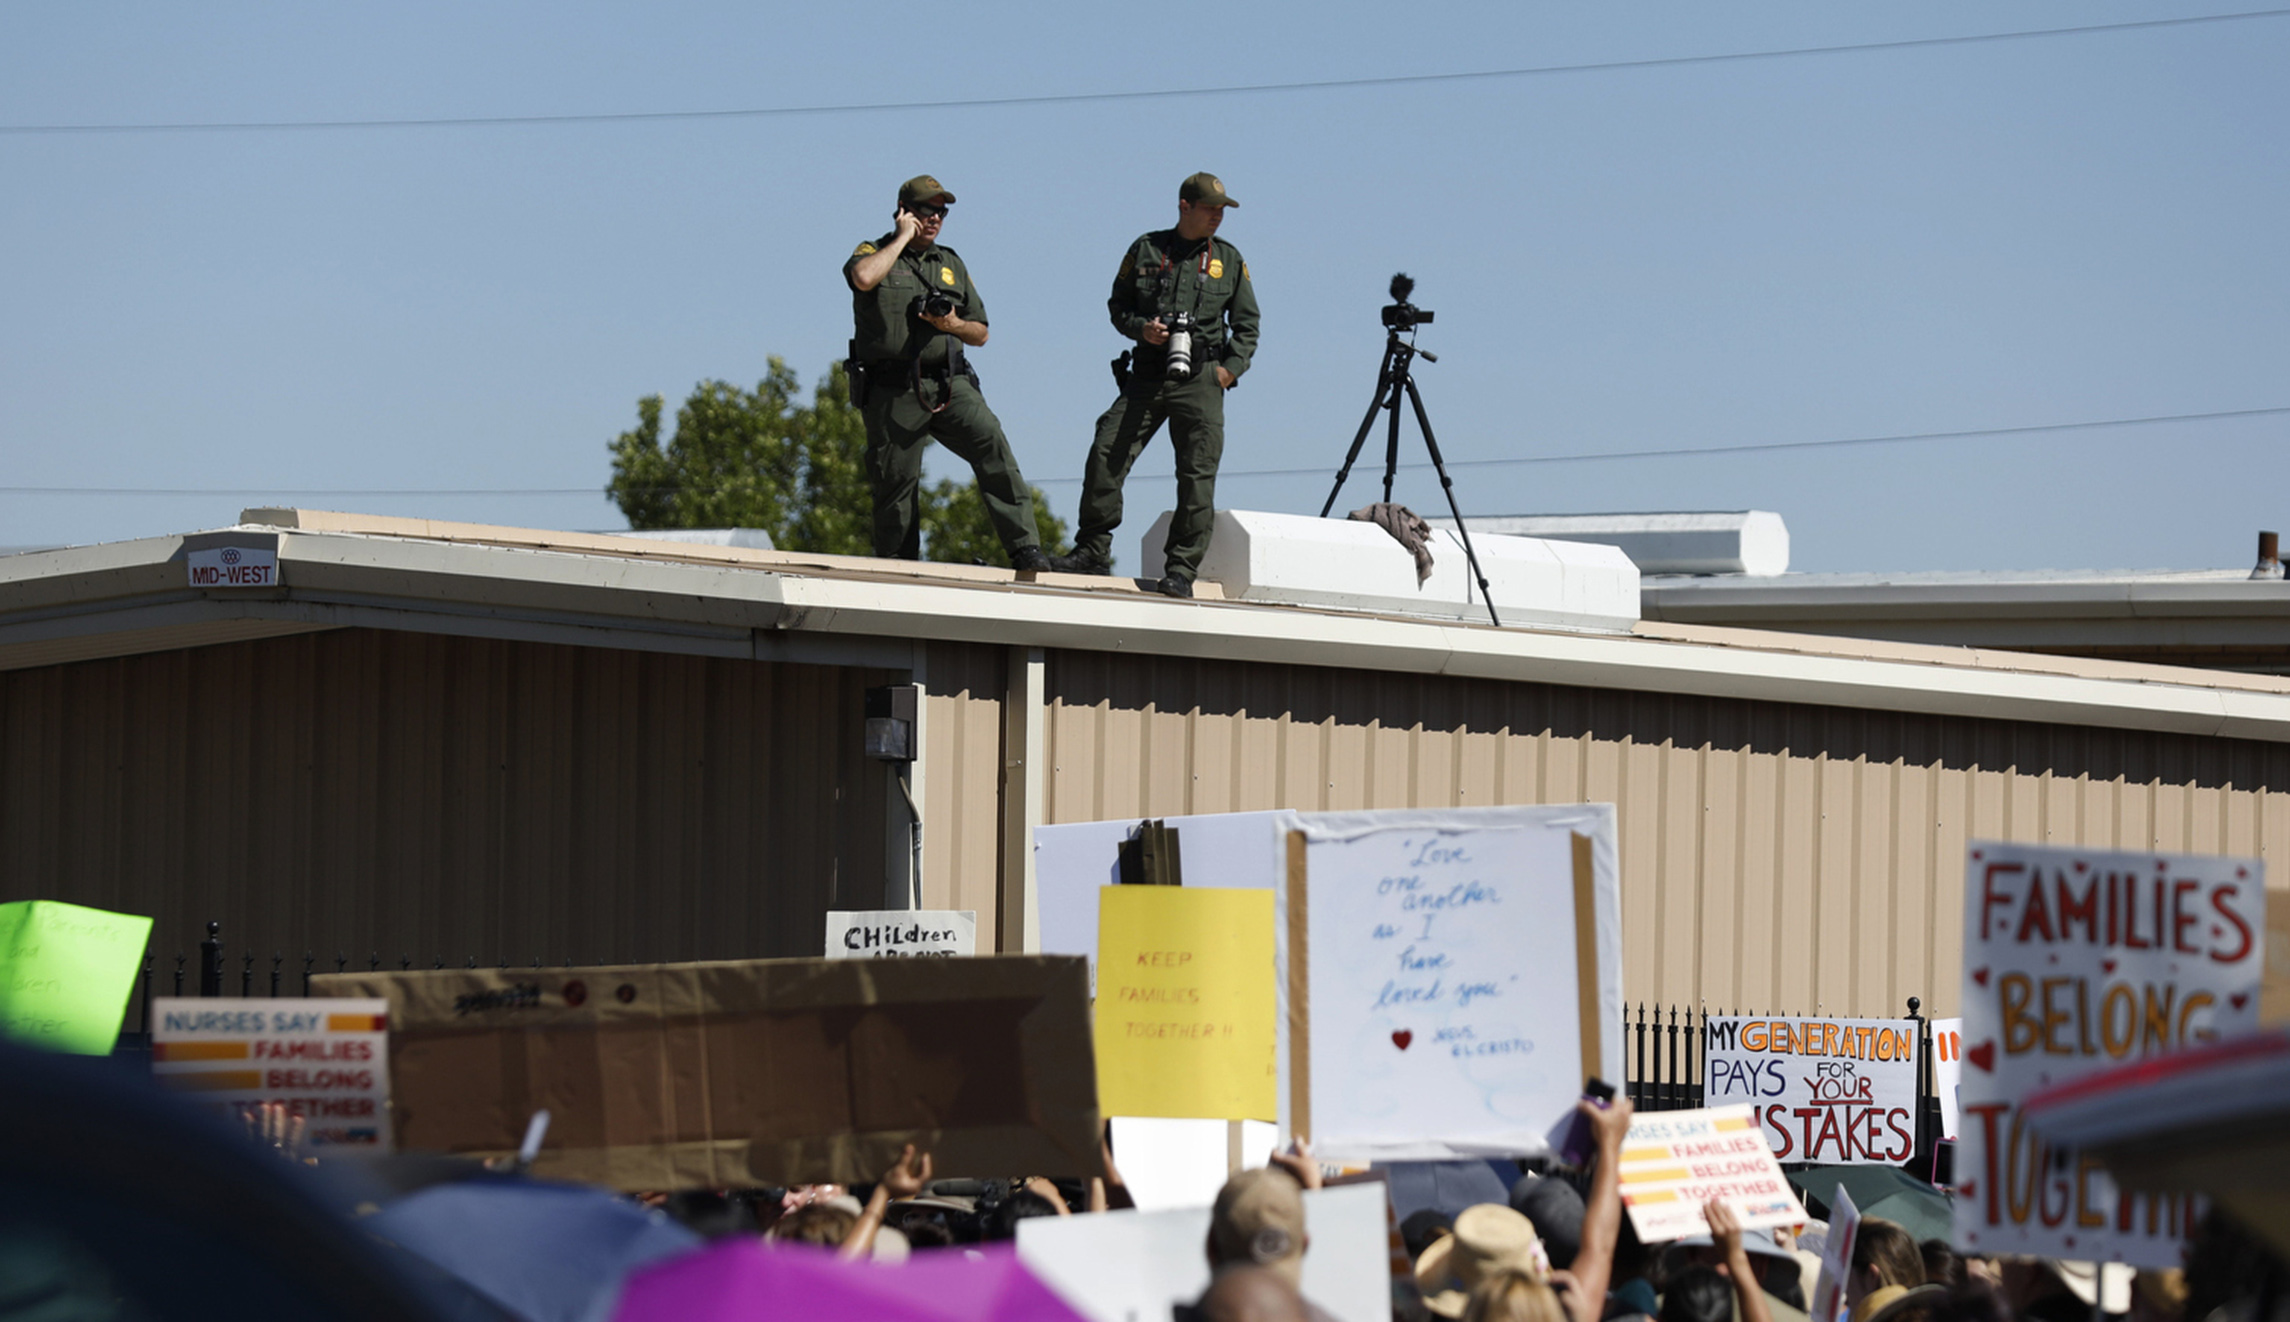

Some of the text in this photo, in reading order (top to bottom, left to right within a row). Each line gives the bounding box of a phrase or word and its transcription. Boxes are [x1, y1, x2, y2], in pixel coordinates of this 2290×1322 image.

[193, 566, 271, 584] MID-WEST
[1377, 875, 1425, 896] one
[1402, 880, 1502, 911] another
[1980, 862, 2253, 964] FAMILIES
[1415, 913, 1436, 941] I
[1137, 951, 1193, 968] KEEP
[1399, 944, 1453, 971] have
[1119, 986, 1200, 1003] FAMILIES
[1370, 979, 1444, 1011] loved
[164, 1011, 321, 1032] NURSES SAY
[1126, 1021, 1215, 1039] TOGETHER
[255, 1040, 372, 1061] FAMILIES
[1709, 1021, 1739, 1050] MY
[1740, 1022, 1912, 1062] GENERATION
[267, 1069, 373, 1090] BELONG
[1711, 1059, 1856, 1097] PAYS FOR
[1803, 1077, 1873, 1100] YOUR
[1675, 1120, 1708, 1137] SAY
[1672, 1137, 1759, 1159] FAMILIES
[1692, 1158, 1770, 1179] BELONG
[1677, 1180, 1780, 1201] TOGETHER
